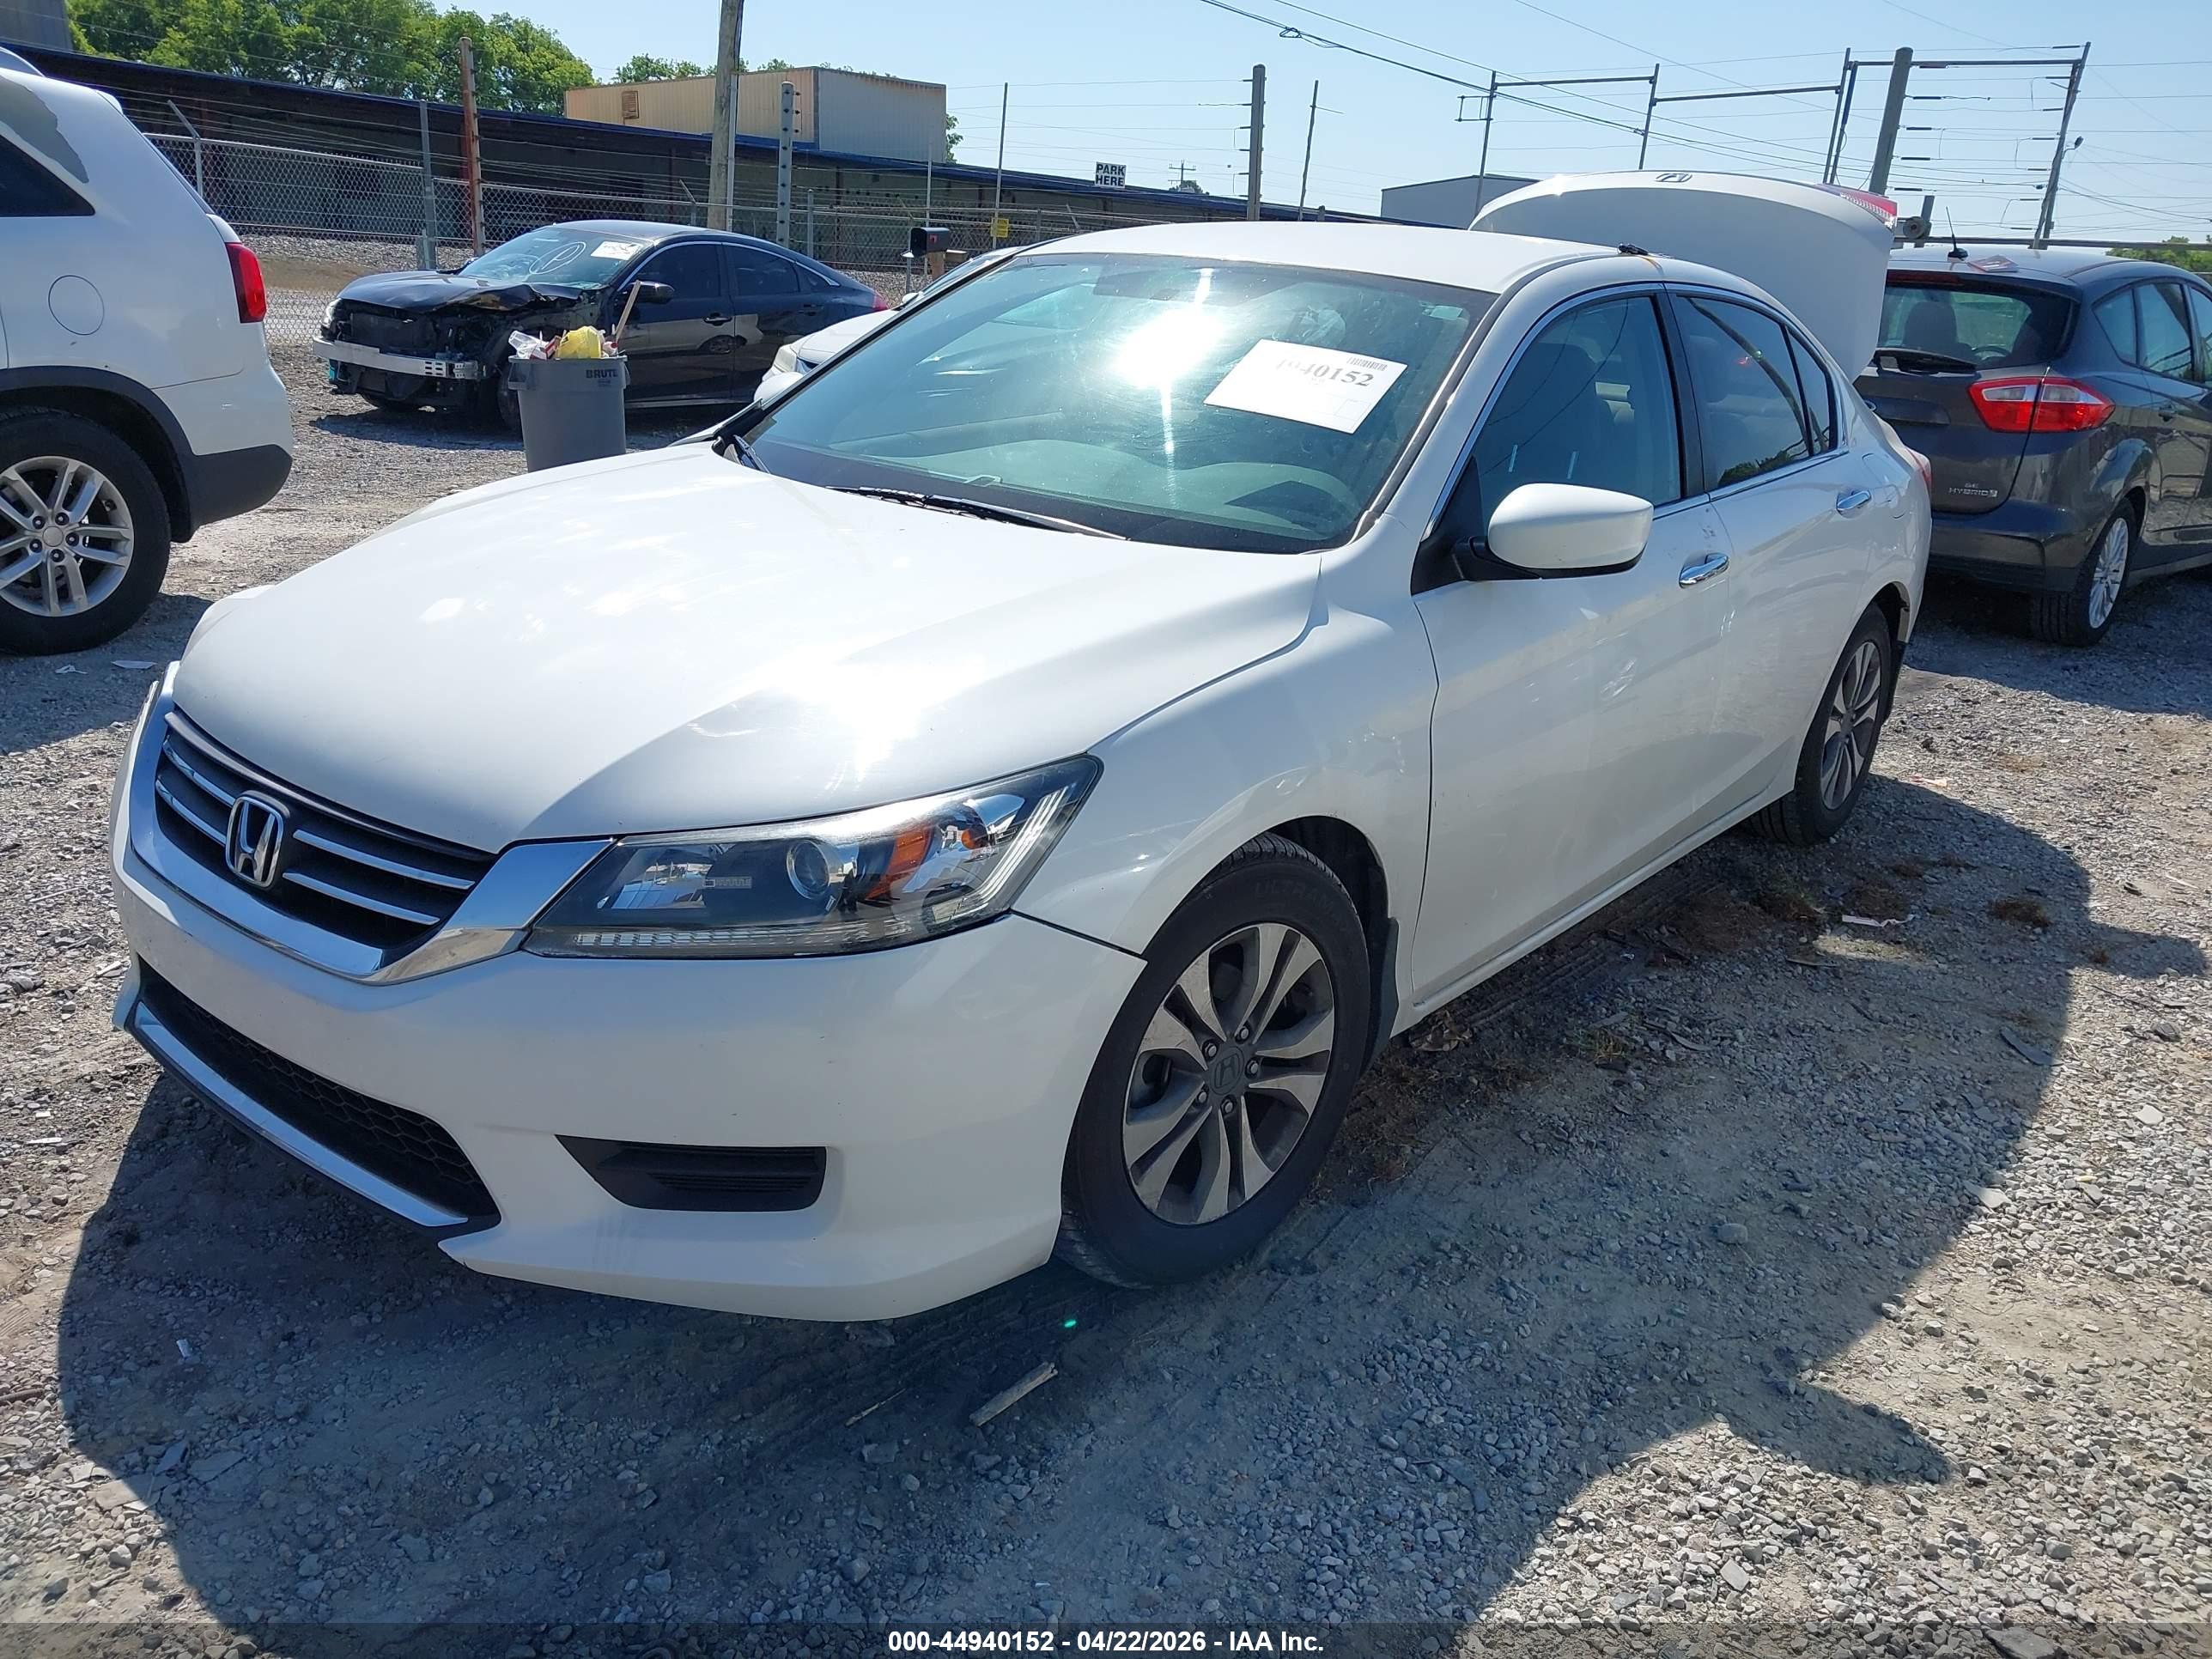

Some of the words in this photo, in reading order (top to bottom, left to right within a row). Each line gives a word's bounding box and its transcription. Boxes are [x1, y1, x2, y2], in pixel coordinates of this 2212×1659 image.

[1096, 163, 1126, 175] PARK
[1095, 174, 1125, 186] HERE
[586, 368, 618, 379] BRUTE
[1948, 487, 1989, 496] HYBRID
